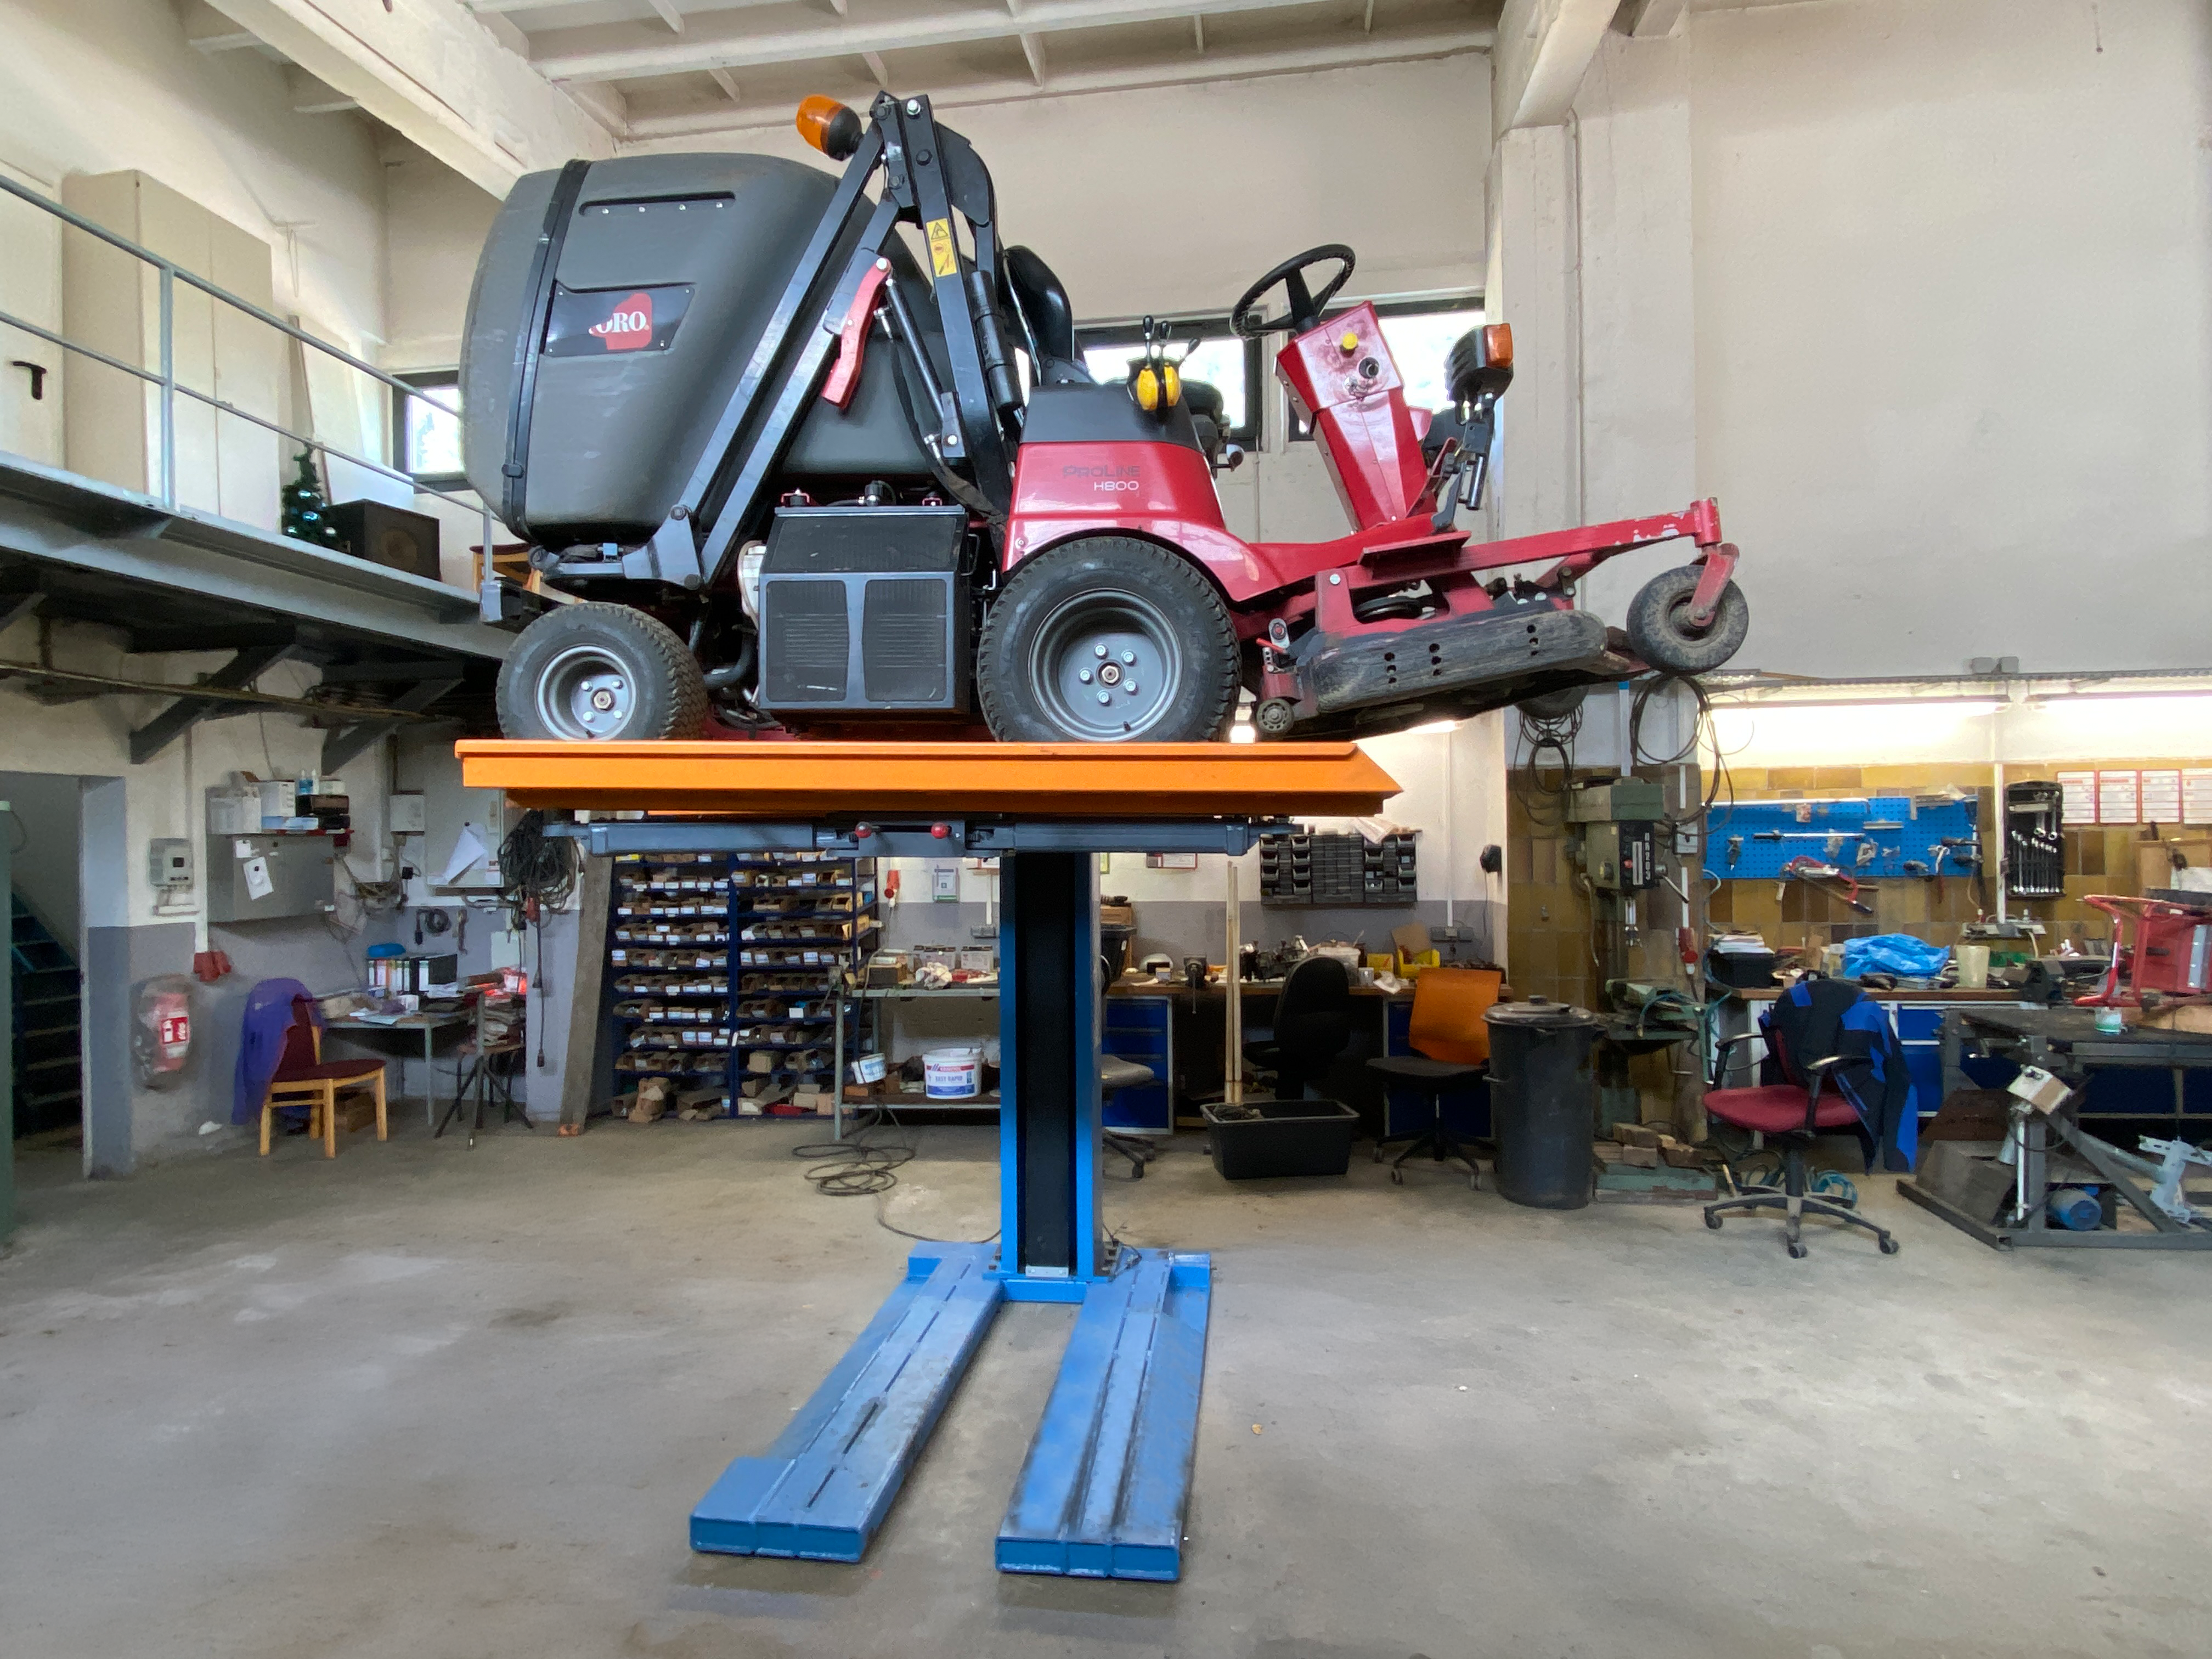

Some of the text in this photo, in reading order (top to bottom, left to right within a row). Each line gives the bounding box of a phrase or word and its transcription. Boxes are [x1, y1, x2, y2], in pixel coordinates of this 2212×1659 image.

[589, 312, 646, 334] ORO
[1063, 466, 1140, 477] PROLINE
[1094, 481, 1139, 491] H800
